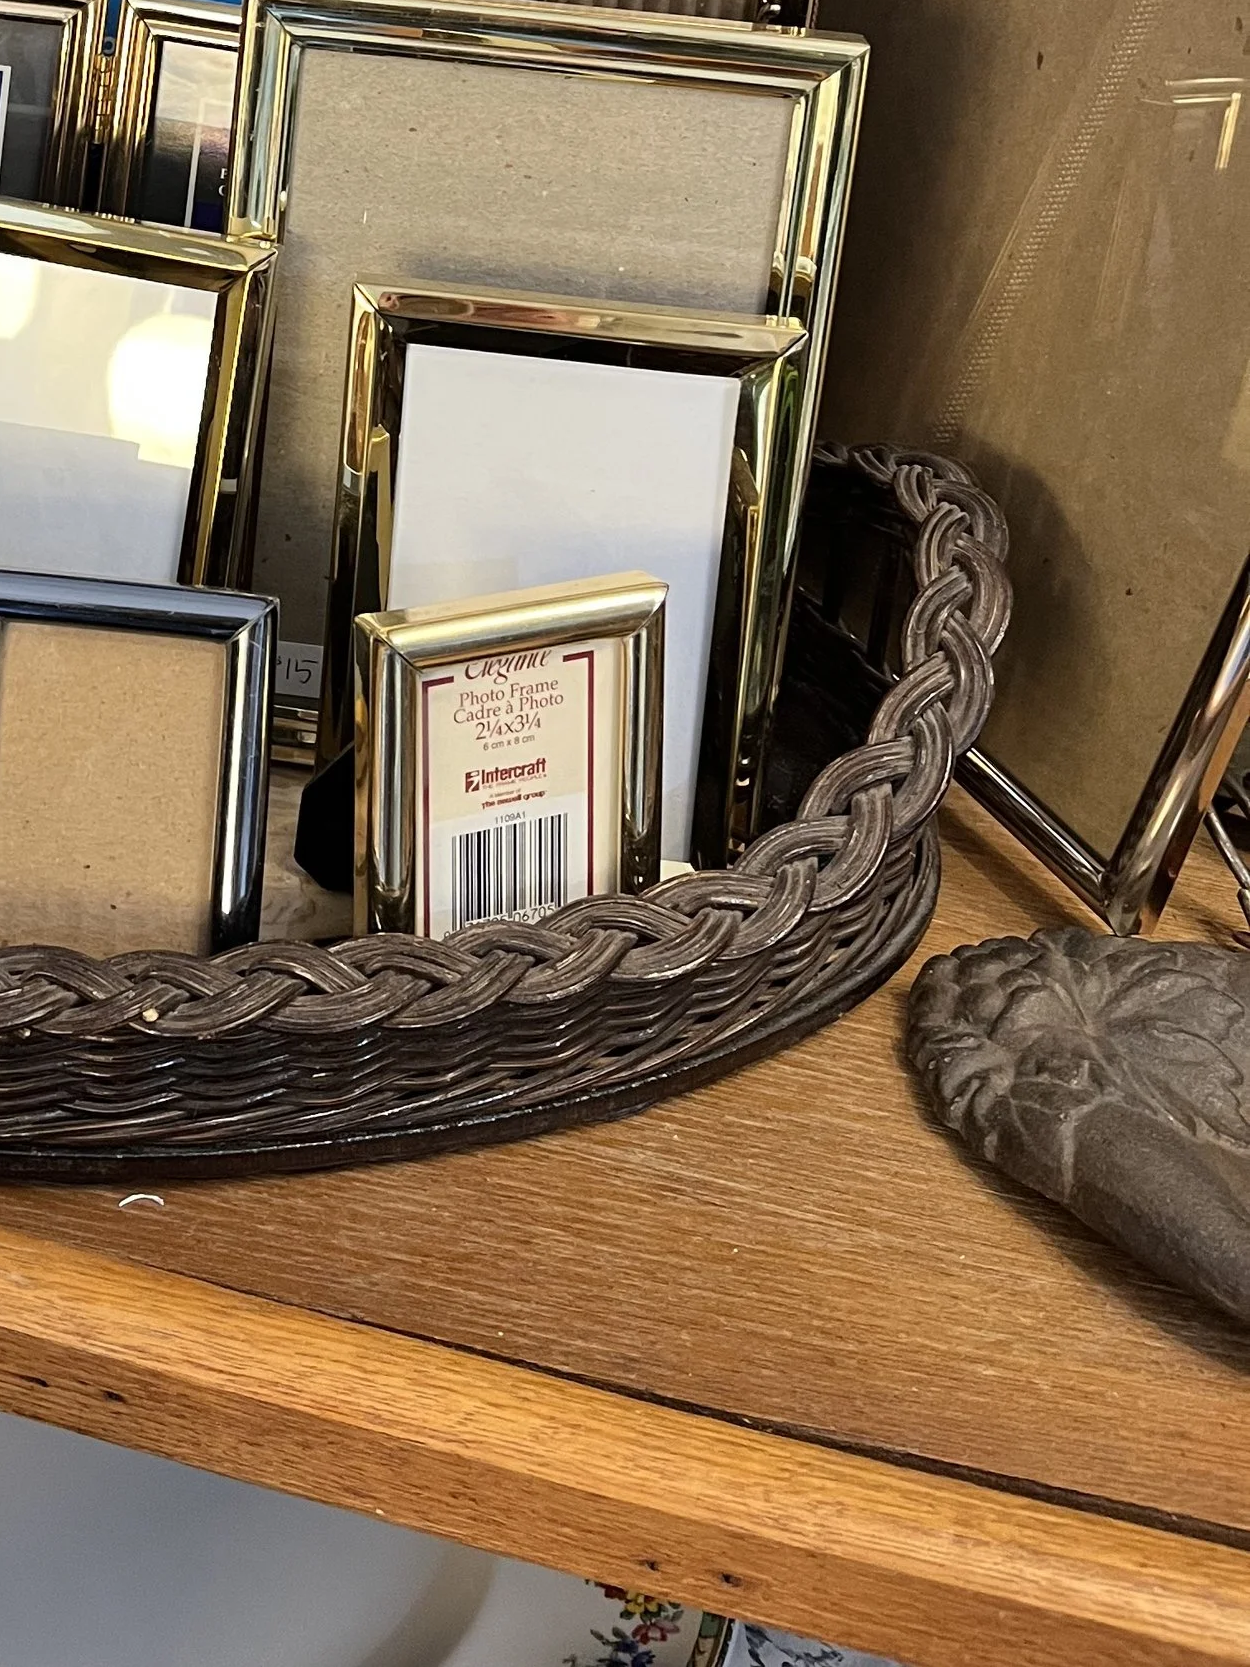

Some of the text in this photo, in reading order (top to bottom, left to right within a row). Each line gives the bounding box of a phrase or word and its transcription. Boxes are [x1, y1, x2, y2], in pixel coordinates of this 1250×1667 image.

[460, 679, 559, 707] Photo Frame
[453, 694, 564, 724] Cadre à Photo
[483, 742, 489, 751] 6
[491, 740, 505, 750] cm
[514, 736, 520, 745] 8
[522, 734, 535, 743] cm
[482, 758, 546, 784] Intercraft
